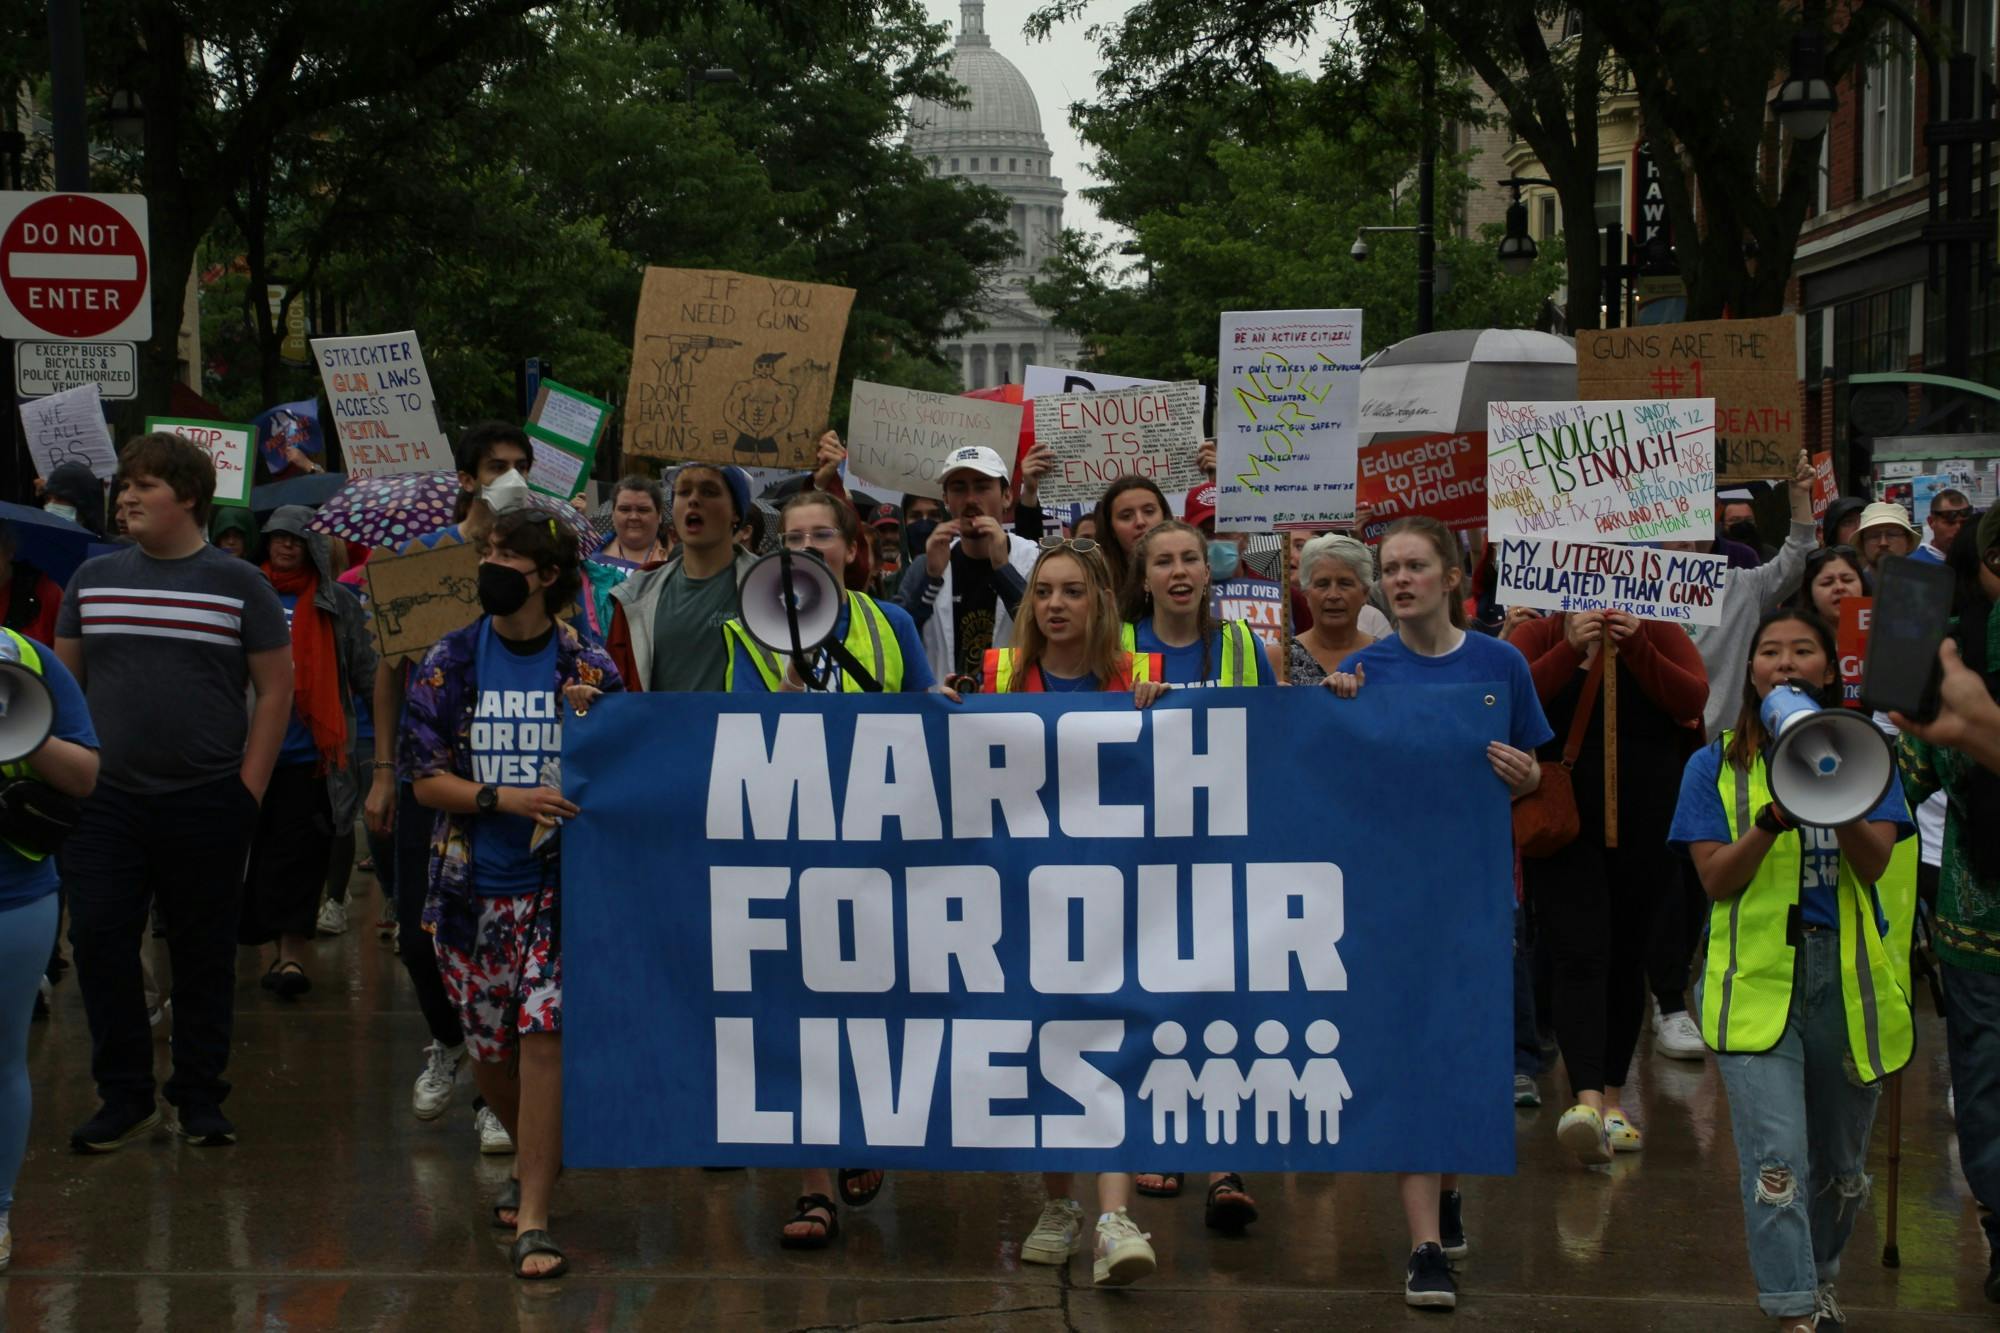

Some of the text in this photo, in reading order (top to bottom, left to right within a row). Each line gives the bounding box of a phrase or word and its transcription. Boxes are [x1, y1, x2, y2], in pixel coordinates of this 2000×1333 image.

[23, 224, 119, 247] DO NOT
[28, 287, 120, 311] ENTER
[702, 275, 812, 309] IF YOU
[681, 303, 810, 333] NEED GUNS
[1235, 330, 1352, 343] BE AN ACTIVE CITIZEN
[1592, 333, 1767, 361] GUNS ARE THE
[36, 345, 117, 357] EXCEPT BUSES
[45, 358, 108, 369] BICYCLES &
[324, 341, 412, 368] STRICKTER
[23, 369, 131, 382] POLICE AUTHORIZED
[332, 368, 421, 394] GUN LAWS
[652, 358, 693, 385] YOU
[1233, 366, 1243, 374] IT
[1249, 365, 1271, 373] ONLY
[1276, 364, 1304, 372] TAKES
[1648, 359, 1705, 400] #1
[52, 382, 104, 394] VEHIS
[640, 383, 696, 403] DONT
[907, 391, 949, 406] MORE
[1232, 351, 1292, 422] NO
[1267, 393, 1306, 402] SENATORS
[39, 403, 69, 426] WE
[335, 392, 422, 417] ACCESS TO
[640, 402, 693, 423] HAVE
[855, 394, 992, 430] MASS SHOOTINGS
[1060, 395, 1170, 429] ENOUGH
[1490, 401, 1510, 418] NO
[1499, 405, 1537, 426] MORE
[1634, 402, 1670, 424] SANDY
[340, 420, 399, 440] MENTAL
[1238, 421, 1341, 433] TO ENACT GUN SAFETY
[1493, 423, 1518, 443] LAS
[1548, 410, 1567, 428] NV
[1570, 405, 1586, 421] '17
[1647, 409, 1704, 436] HOOK '12
[1715, 408, 1792, 433] DEATH
[39, 424, 84, 446] CALL
[632, 424, 702, 453] GUNS
[873, 420, 967, 451] THAN DAYS
[1101, 432, 1140, 455] IS
[1517, 409, 1627, 470] ENOUGH
[350, 441, 430, 465] HEALTH
[857, 443, 886, 467] IN
[1361, 436, 1472, 478] Educators
[1548, 461, 1577, 493] IS
[1578, 430, 1678, 487] ENOUGH
[1681, 442, 1704, 458] NO
[1064, 455, 1171, 483] ENOUGH
[1385, 459, 1456, 493] to End
[1490, 459, 1517, 477] NO
[1677, 453, 1714, 477] MORE
[1221, 485, 1242, 493] LEARN
[1250, 484, 1269, 492] THEIR
[1494, 469, 1540, 493] MORE
[1614, 474, 1645, 495] PULSE
[1371, 476, 1488, 516] un Violenc
[1488, 486, 1536, 511] VIRGINIA
[1514, 498, 1546, 517] TECH
[1654, 502, 1673, 520] FL
[1671, 496, 1689, 512] '18
[1273, 513, 1295, 522] SEND
[1319, 512, 1355, 521] PACKING
[1568, 503, 1590, 522] TX
[1591, 496, 1616, 517] '22
[1628, 508, 1713, 540] COLUMBINE '99
[1502, 539, 1726, 589] MY UTERUS IS MORE
[1226, 583, 1250, 596] NOT
[1252, 584, 1280, 599] OVER
[1501, 564, 1714, 607] REGULATED THAN GUNS
[1221, 600, 1281, 625] NEXT
[1561, 596, 1691, 619] #MARCH FOR OUR LIVES
[474, 690, 555, 718] ARC
[470, 722, 562, 752] OR OU
[471, 755, 539, 784] IVES
[706, 707, 1248, 841] MARCH
[709, 861, 1348, 994] FOR OUR
[713, 1016, 1126, 1149] LIVES
